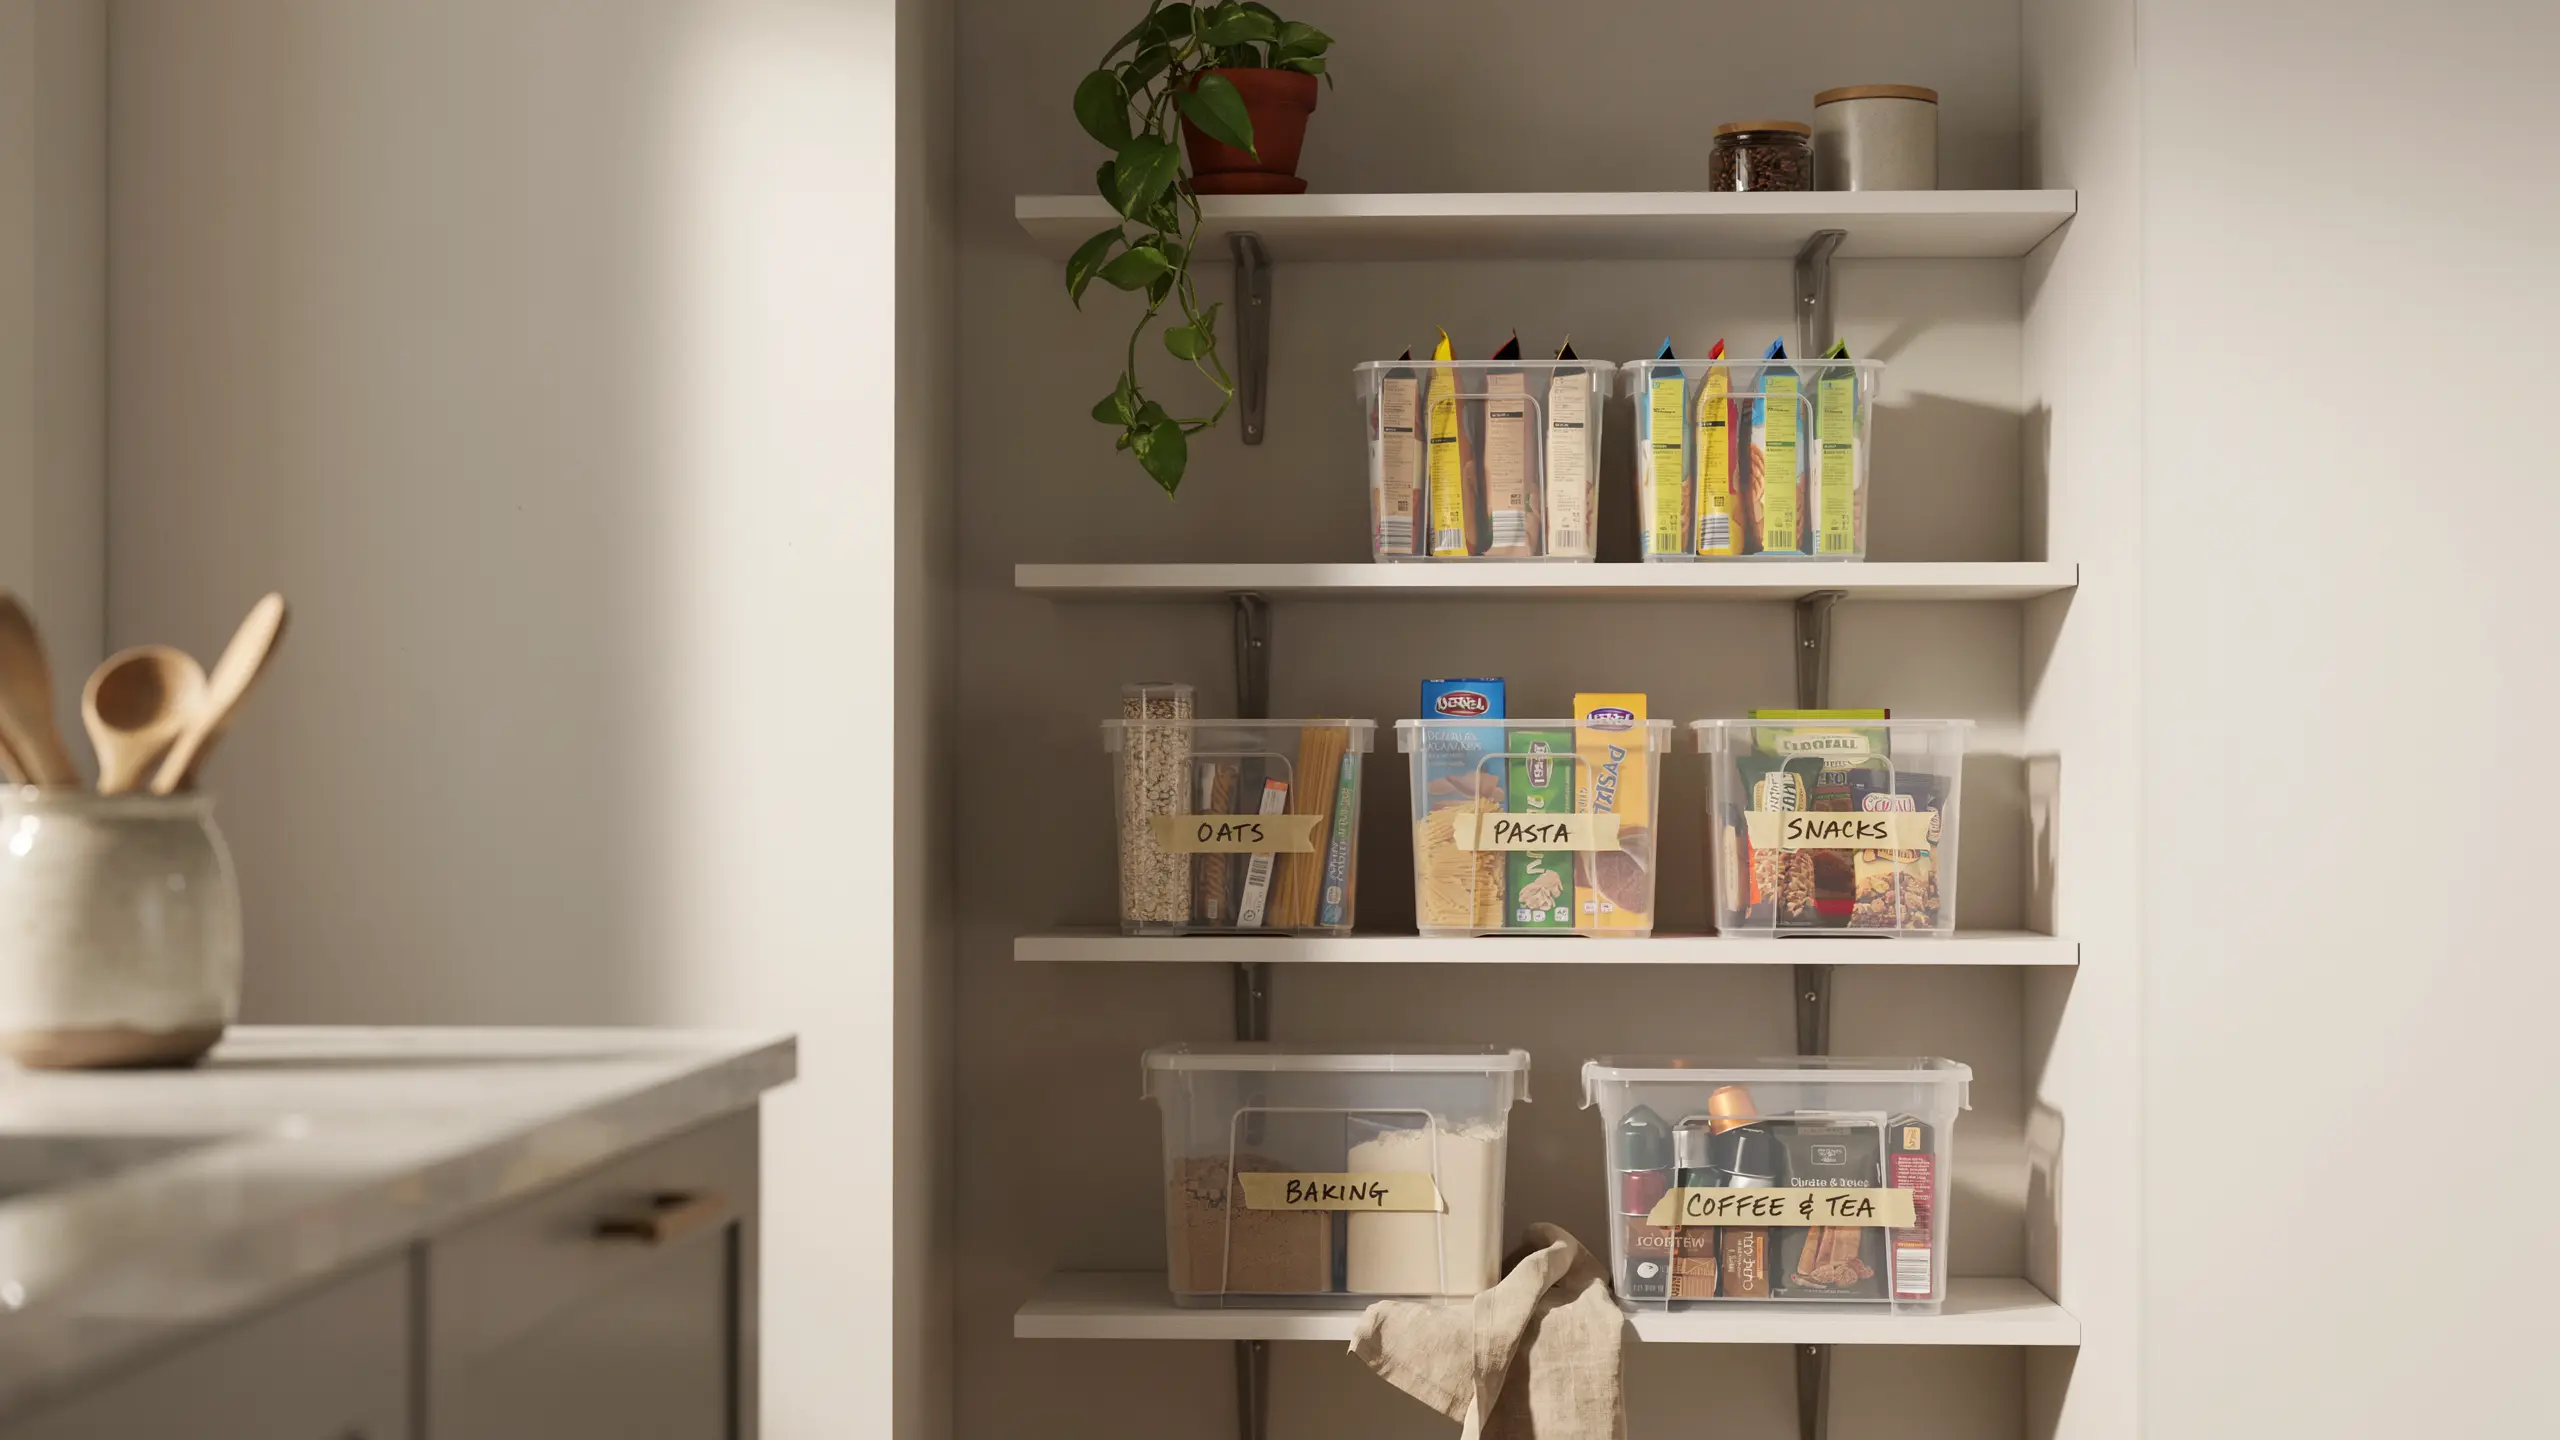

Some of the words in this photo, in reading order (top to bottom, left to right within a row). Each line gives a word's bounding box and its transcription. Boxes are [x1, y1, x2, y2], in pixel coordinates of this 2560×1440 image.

[1197, 822, 1264, 843] OATS
[1494, 819, 1572, 844] PASTA
[1787, 818, 1888, 840] SNACKS
[1286, 1180, 1389, 1206] BAKING
[1687, 1193, 1786, 1217] COFFEE
[1799, 1193, 1814, 1220] &
[1826, 1194, 1876, 1218] TEA
